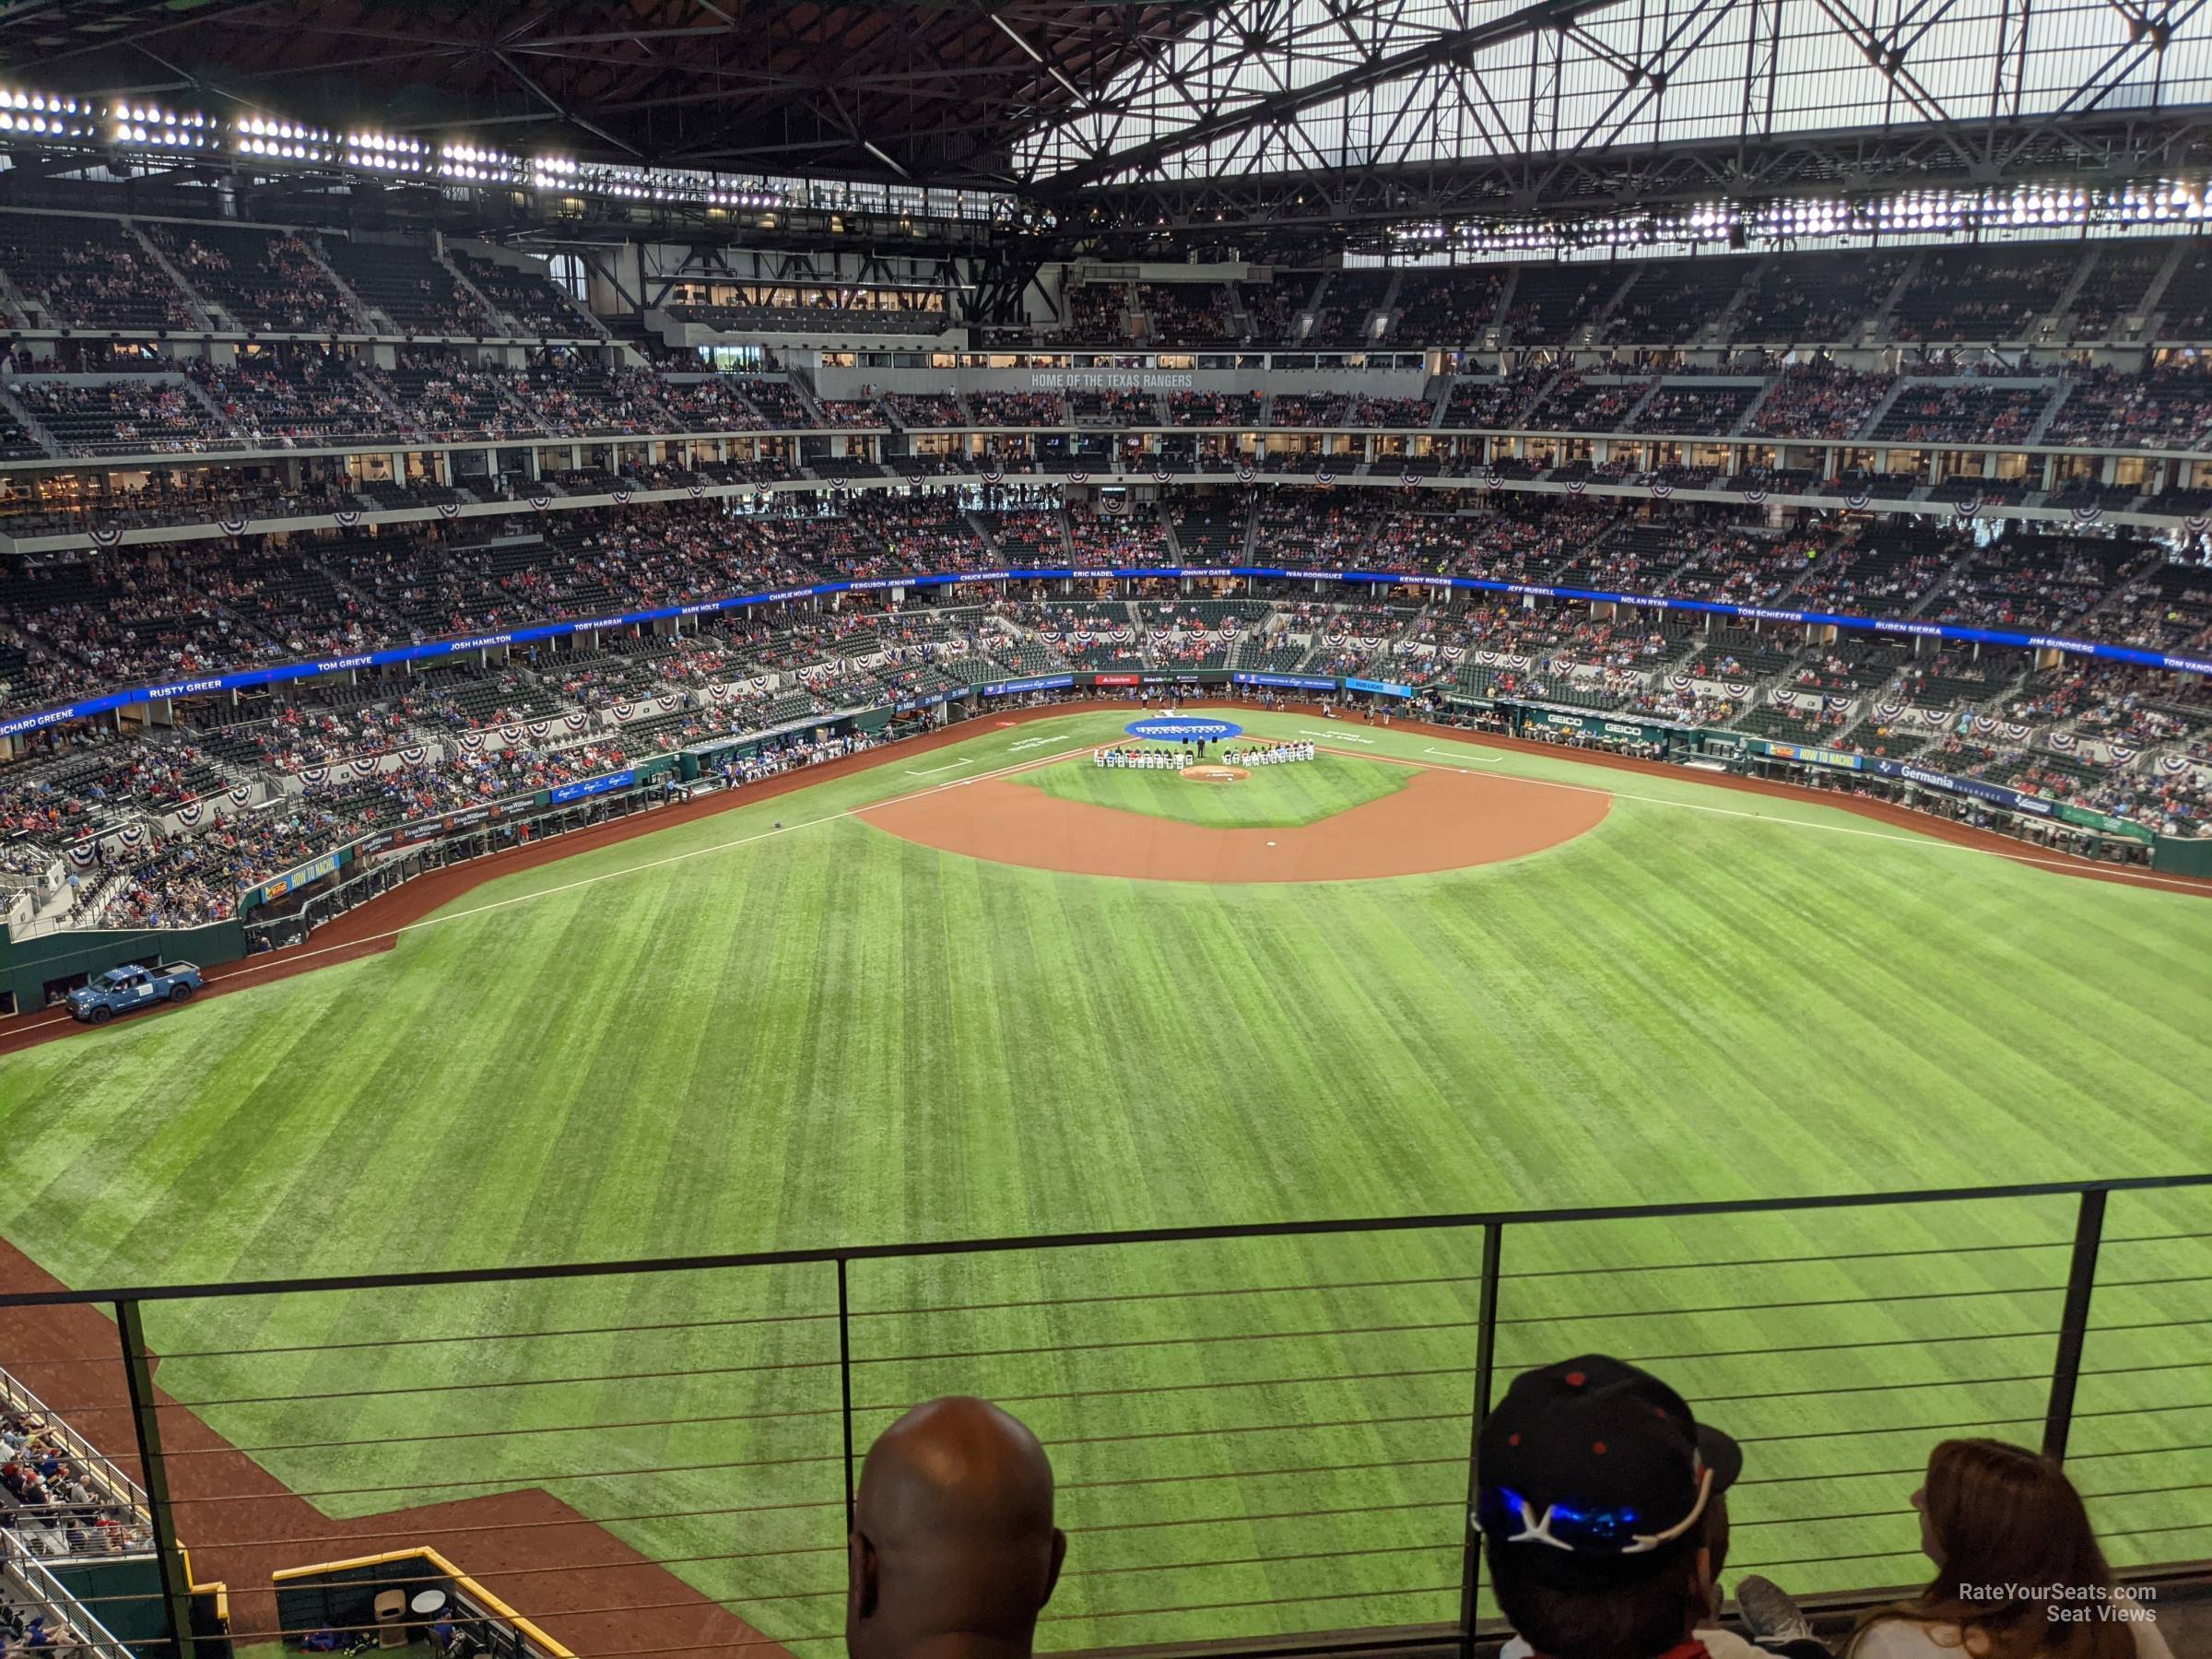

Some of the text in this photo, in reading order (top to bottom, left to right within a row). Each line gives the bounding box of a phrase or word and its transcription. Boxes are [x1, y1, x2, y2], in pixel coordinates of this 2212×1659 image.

[1031, 374, 1192, 387] HOME OF THE TEXAS RANGERS
[960, 571, 1009, 582] CHUCK MORGAN
[1425, 577, 1452, 585] ROGERS
[851, 578, 916, 590] FERGUSON JENKINS
[1507, 585, 1555, 595] JEFF RUSSELL
[769, 591, 793, 600] CHARLIE
[1620, 596, 1668, 607] NOLAN RYAN
[681, 603, 720, 615] MARK HOLTZ
[1737, 607, 1802, 620] TOM SCHIEFFER
[574, 618, 622, 631] TOBY HARRAH
[1875, 622, 1942, 635] RUBEN SIERRA
[450, 634, 512, 651] JOSH HAMILTON
[2027, 638, 2095, 653] JIM SUNDBERG
[317, 656, 372, 672] TOM GRIEVE
[2163, 658, 2183, 667] TOM
[149, 680, 222, 699] RUSTY GREER
[38, 709, 75, 725] GREENE
[1547, 713, 1583, 726] GEICO
[1605, 723, 1641, 736] GEICO
[1799, 747, 1818, 761] HOW
[1819, 751, 1828, 763] TO
[1900, 766, 2001, 802] Germania INSURANCE
[291, 870, 306, 888] HOW
[307, 865, 314, 881] TO
